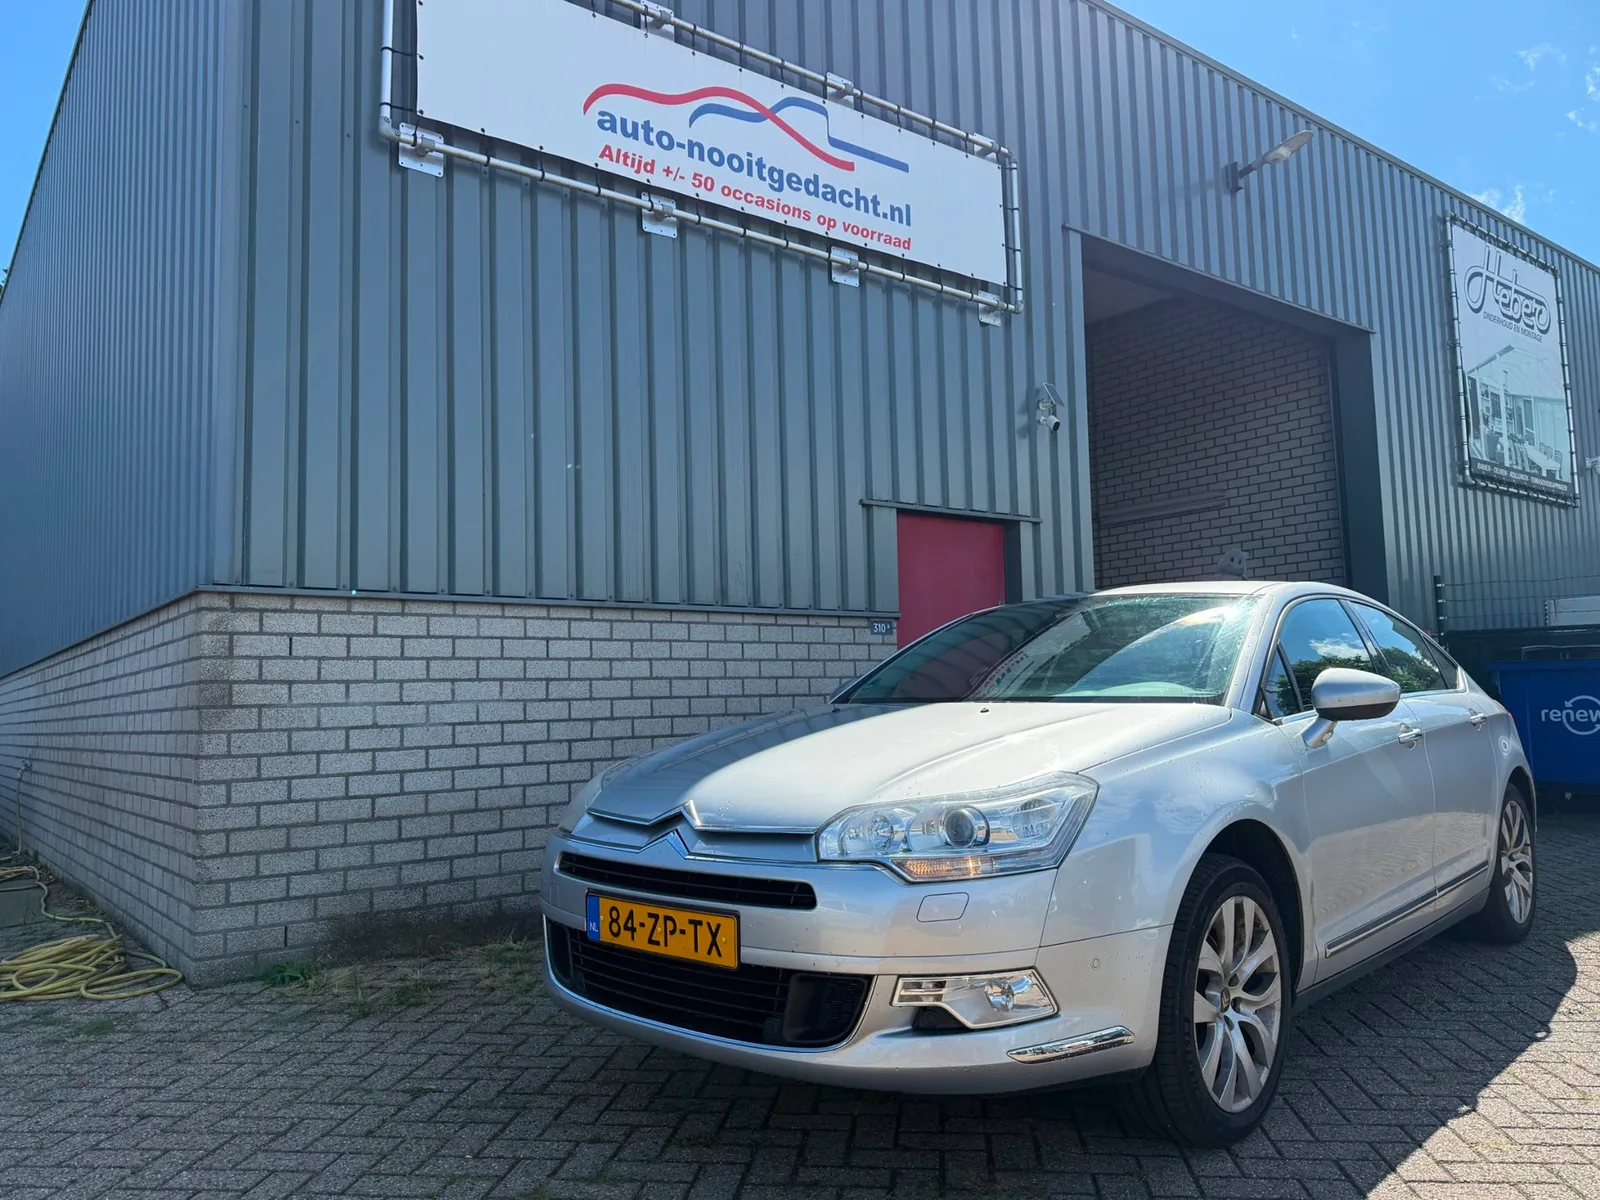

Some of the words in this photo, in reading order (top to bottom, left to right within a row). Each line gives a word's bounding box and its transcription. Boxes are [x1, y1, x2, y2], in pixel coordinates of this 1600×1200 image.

[597, 110, 912, 227] auto-nooitgedacht.nl
[599, 144, 655, 175] Altijd
[662, 165, 686, 182] +/-
[691, 172, 715, 192] 50
[720, 182, 812, 222] occasions
[817, 213, 837, 232] op
[842, 221, 912, 251] voorraad
[1483, 311, 1513, 330] ONDERHOUD
[1513, 325, 1520, 333] EN
[1521, 328, 1543, 342] MONTAGE
[589, 921, 599, 933] NL
[608, 905, 723, 958] 84-ZP-TX
